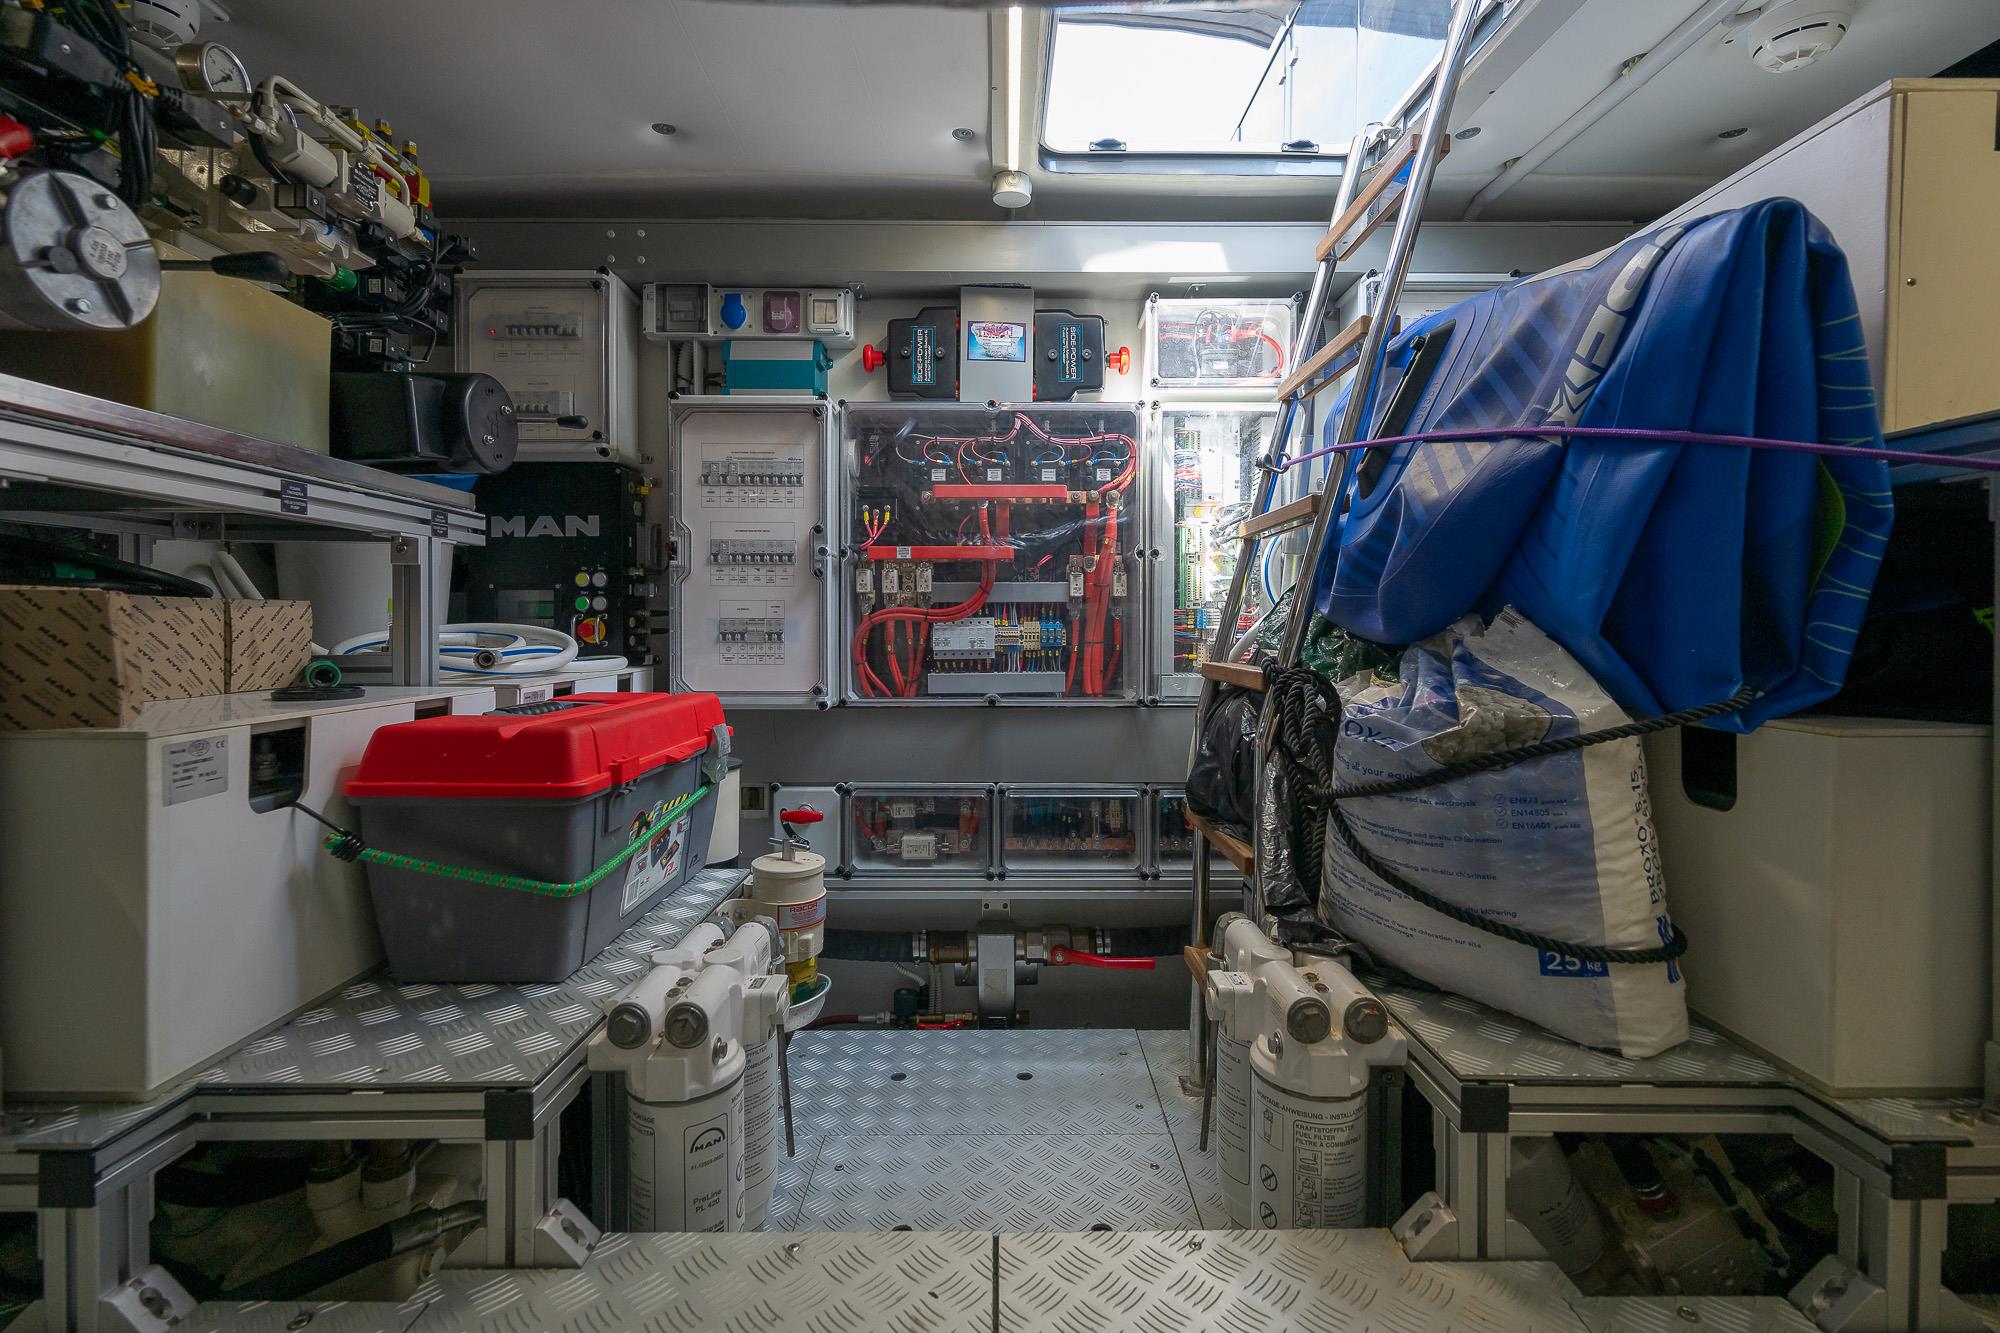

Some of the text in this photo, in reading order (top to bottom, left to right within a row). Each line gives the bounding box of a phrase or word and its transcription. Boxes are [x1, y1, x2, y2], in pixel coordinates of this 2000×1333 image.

[490, 514, 600, 538] MAN
[1361, 765, 1385, 779] your
[1545, 951, 1603, 972] 25 kg
[694, 1135, 723, 1153] MAN
[1295, 1131, 1336, 1142] FUEL FILTER
[693, 1188, 722, 1206] ProLine
